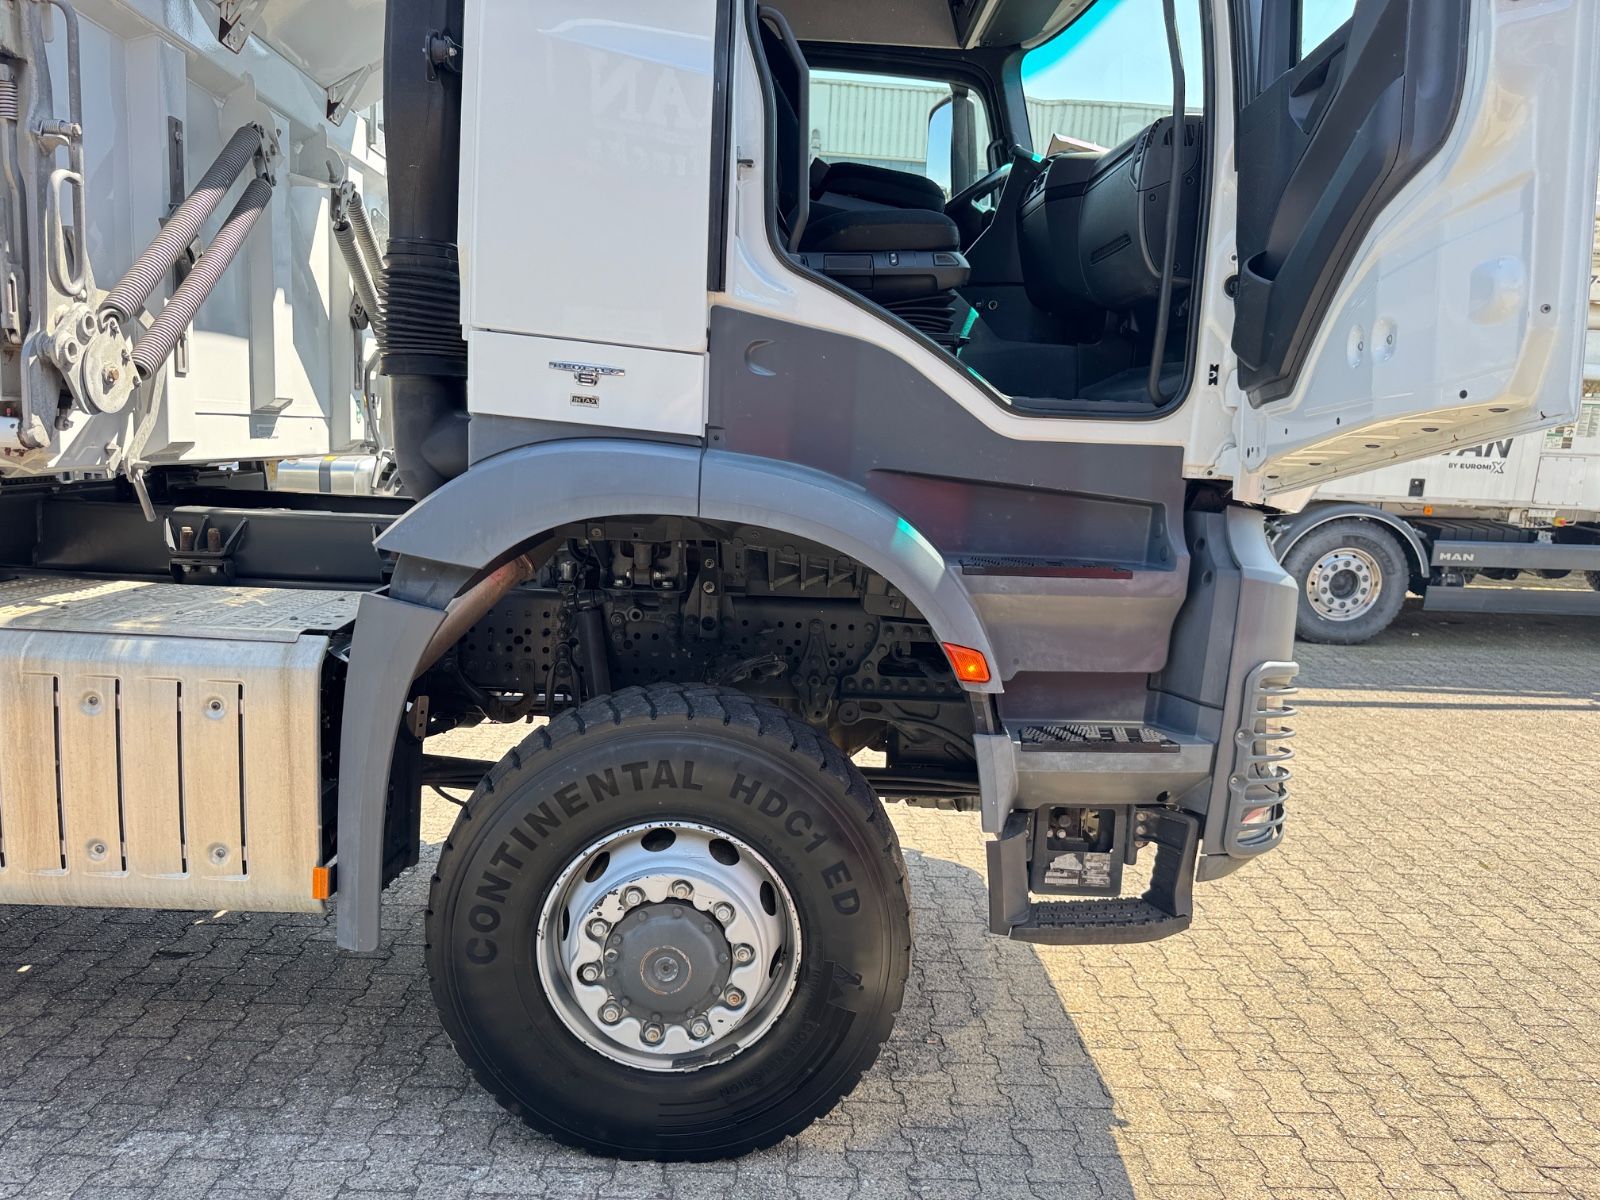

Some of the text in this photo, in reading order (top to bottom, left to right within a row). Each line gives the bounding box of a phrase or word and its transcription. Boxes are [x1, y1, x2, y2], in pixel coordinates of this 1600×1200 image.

[1442, 438, 1514, 458] AN
[1460, 461, 1506, 474] EUROMIX
[1439, 552, 1475, 561] MAN
[465, 758, 704, 965] CONTINENTAL
[728, 772, 830, 855] HDC1
[820, 862, 862, 917] ED
